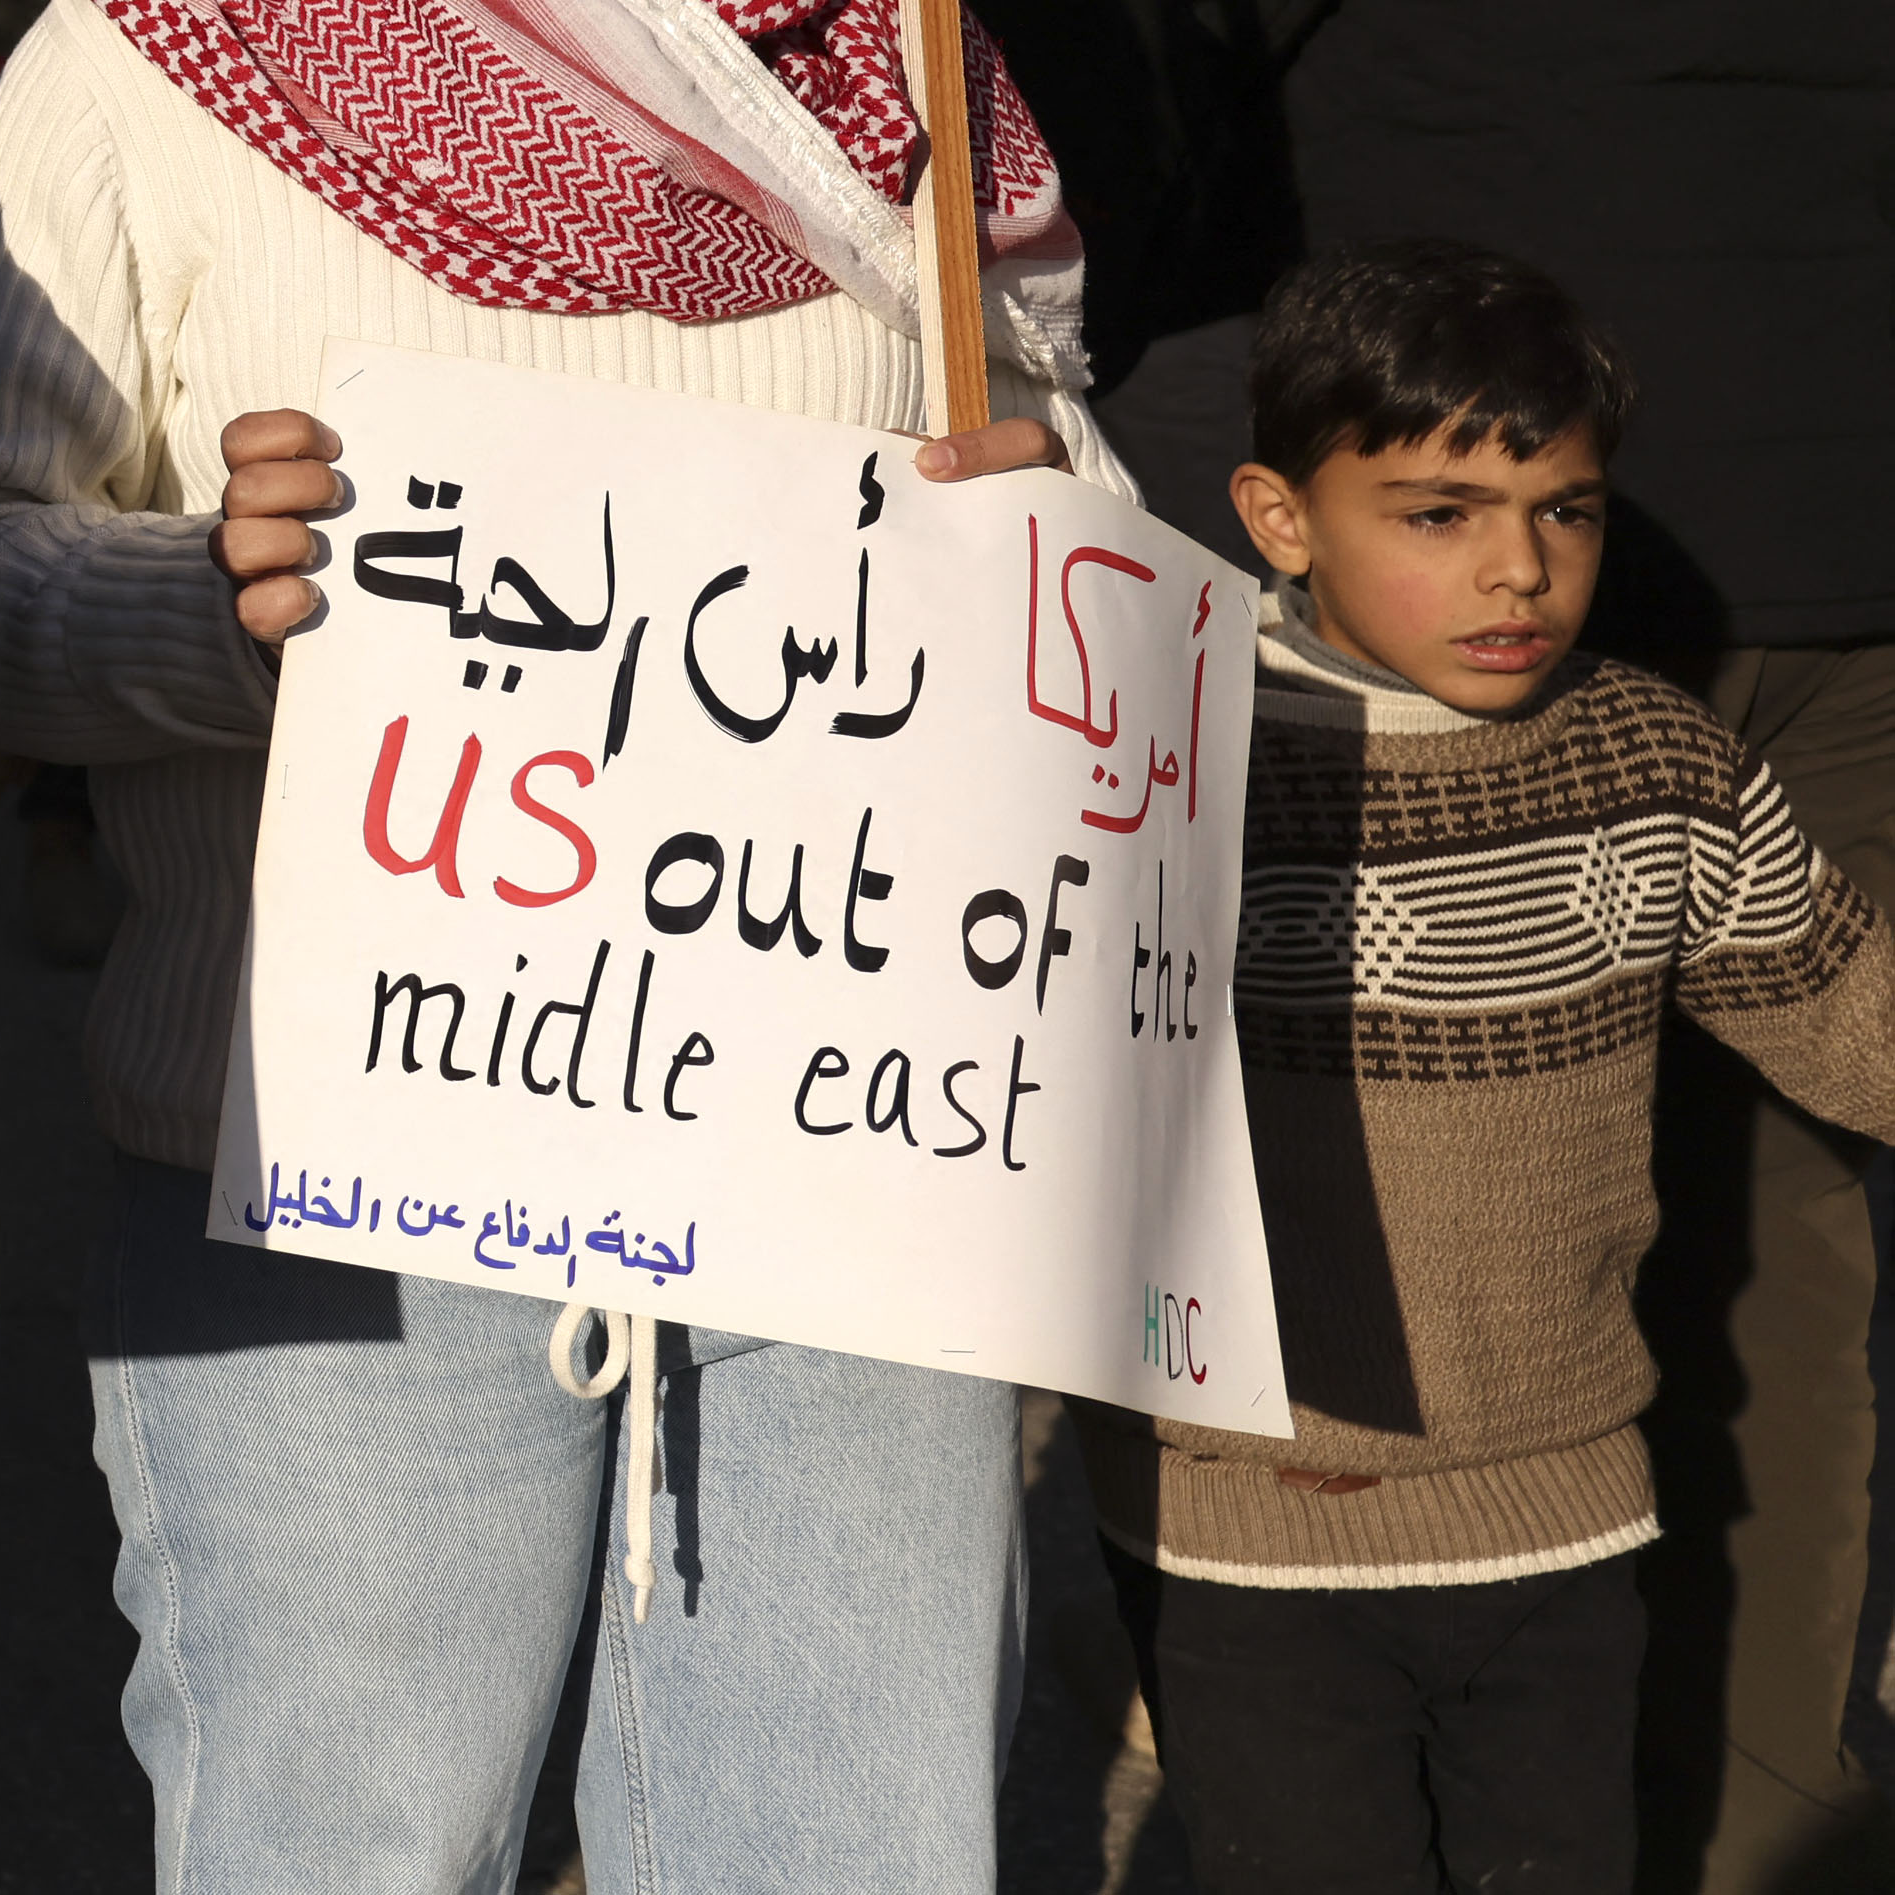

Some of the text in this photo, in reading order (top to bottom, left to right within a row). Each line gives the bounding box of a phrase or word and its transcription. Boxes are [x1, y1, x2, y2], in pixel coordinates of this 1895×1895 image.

[683, 451, 926, 744] رأس
[643, 806, 896, 973] out
[1131, 862, 1198, 1042] the
[364, 938, 1041, 1171] midle east
[245, 1163, 695, 1287] لجنة الدفاع عن الخليل
[1143, 1284, 1207, 1387] HDC
